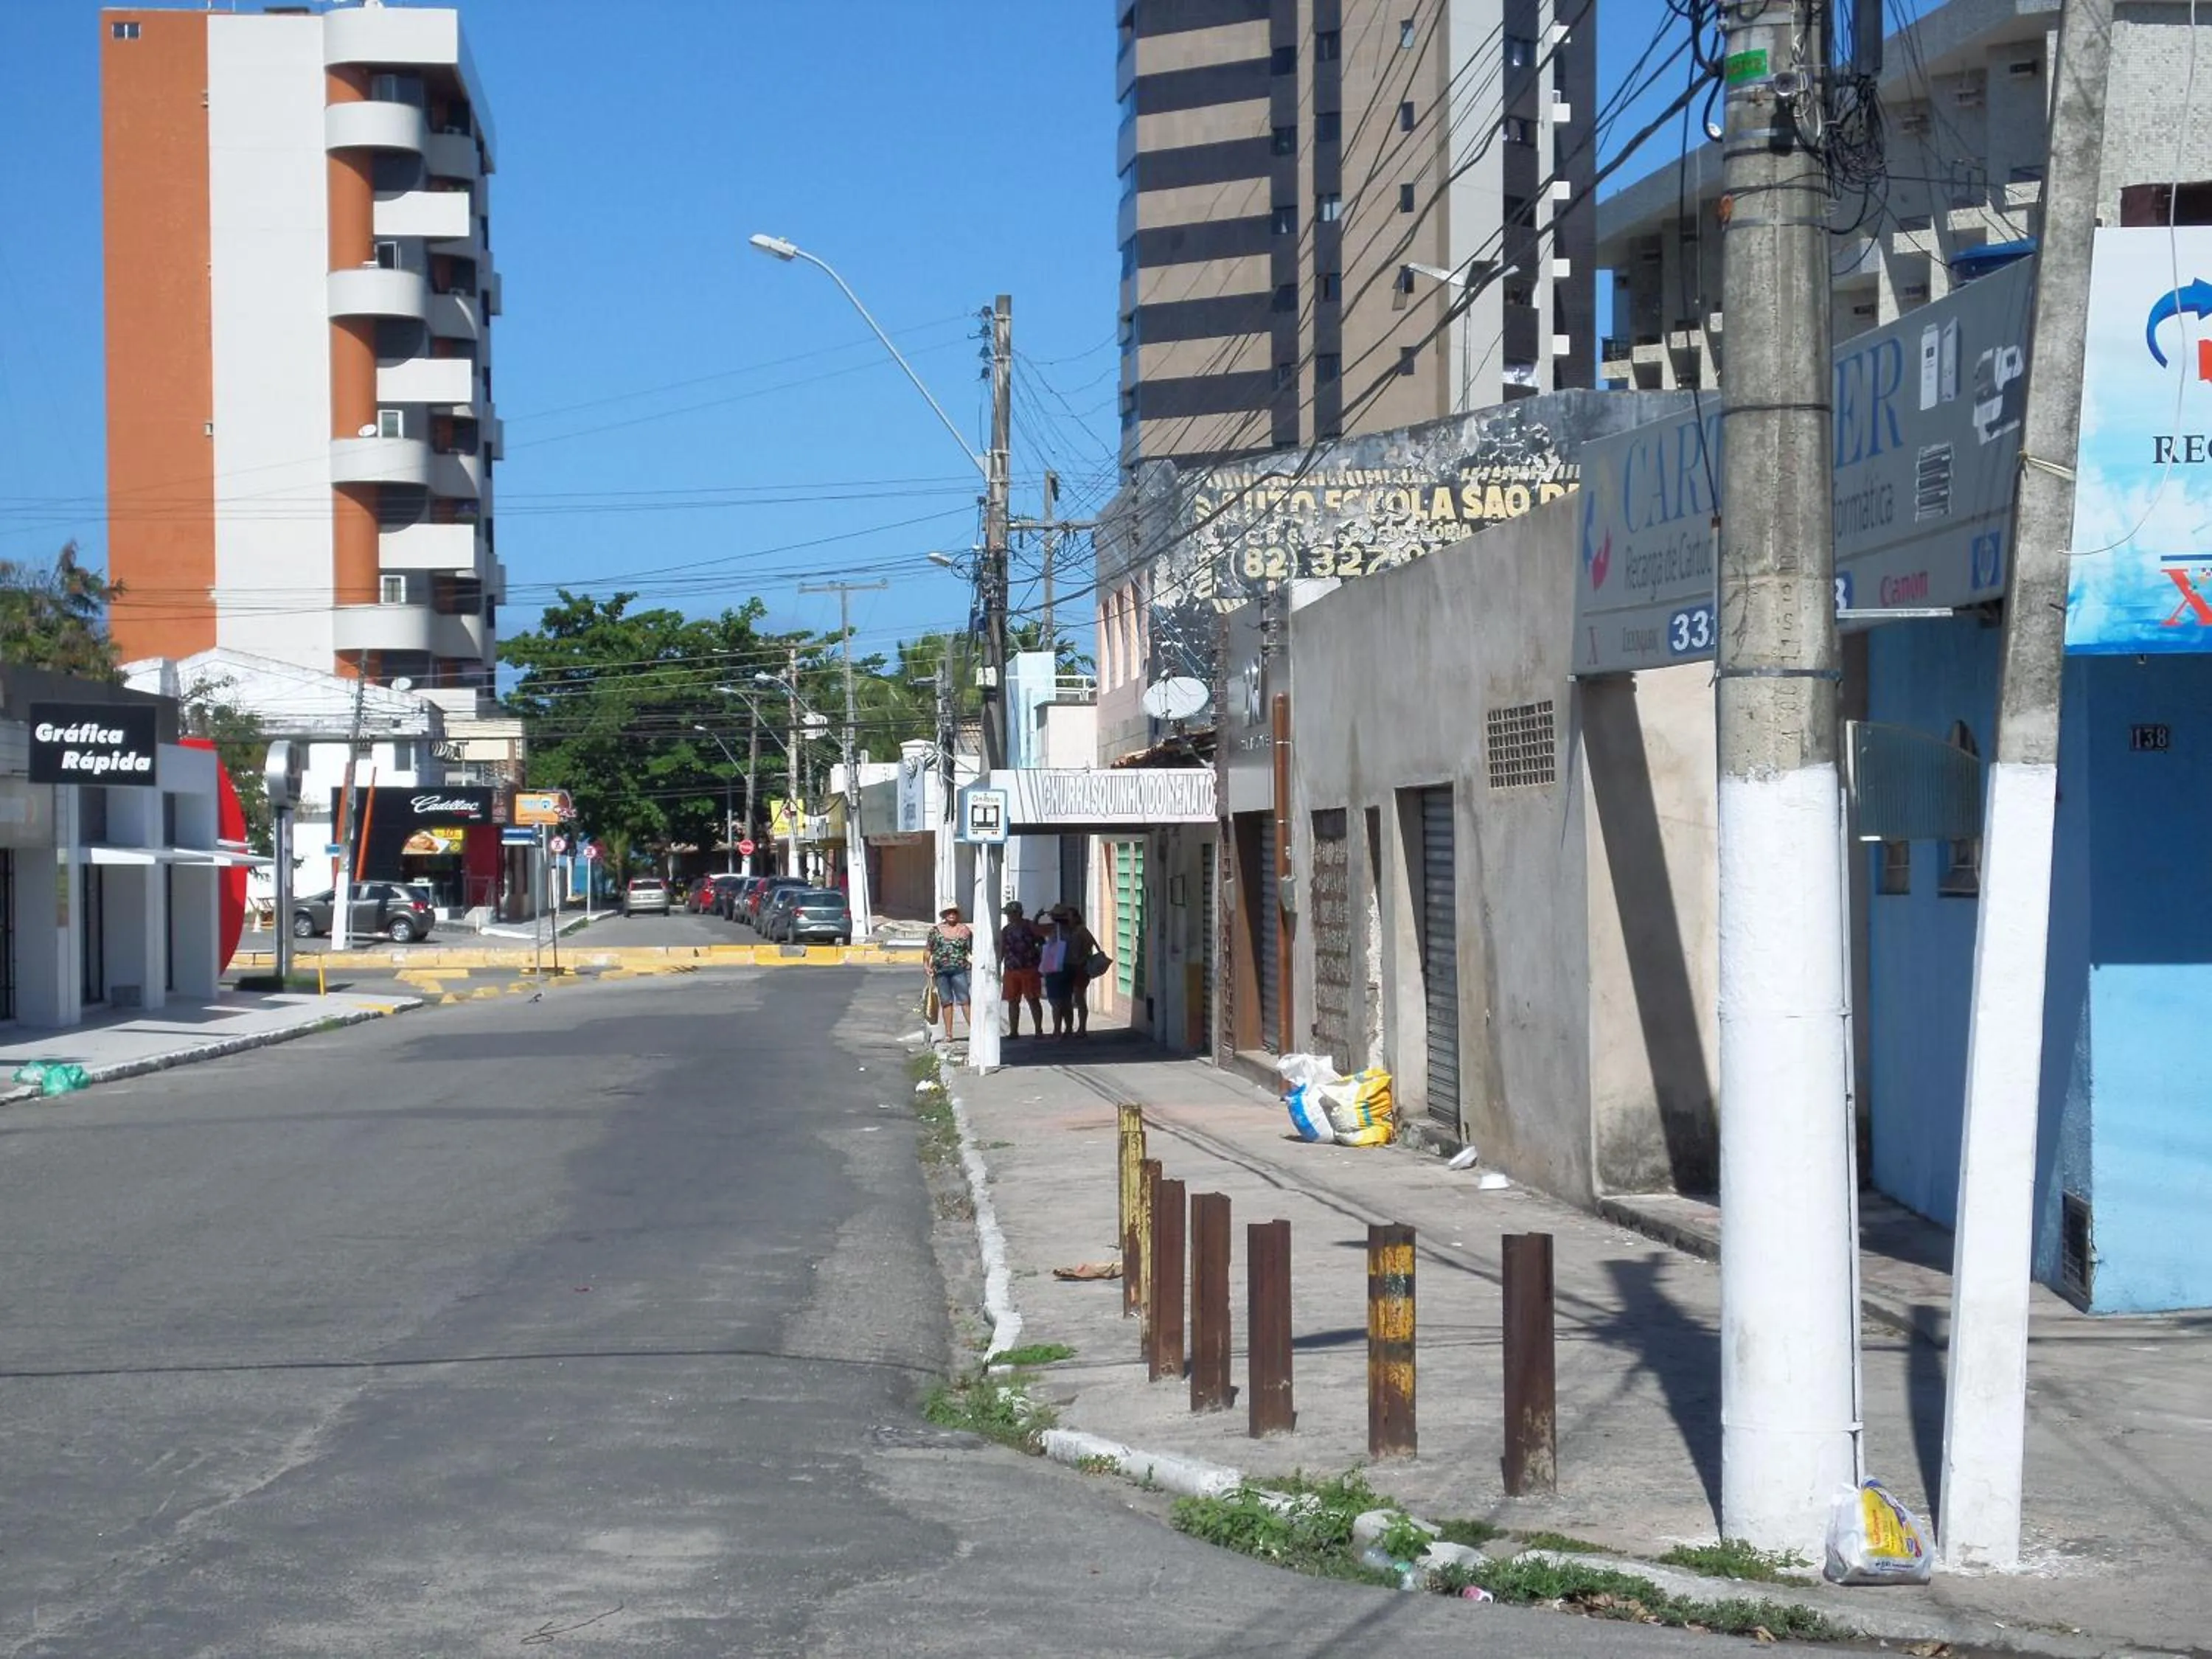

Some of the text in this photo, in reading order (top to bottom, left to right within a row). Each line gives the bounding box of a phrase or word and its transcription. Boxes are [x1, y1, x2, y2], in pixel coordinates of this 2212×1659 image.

[2152, 434, 2212, 464] RE
[1461, 479, 1530, 519] SÃO
[1672, 611, 1717, 651] 33
[1880, 571, 1928, 607] Canon
[35, 723, 124, 744] Gráfica
[2135, 728, 2166, 748] 138
[61, 751, 151, 774] Rápida
[410, 796, 479, 813] Cadillac
